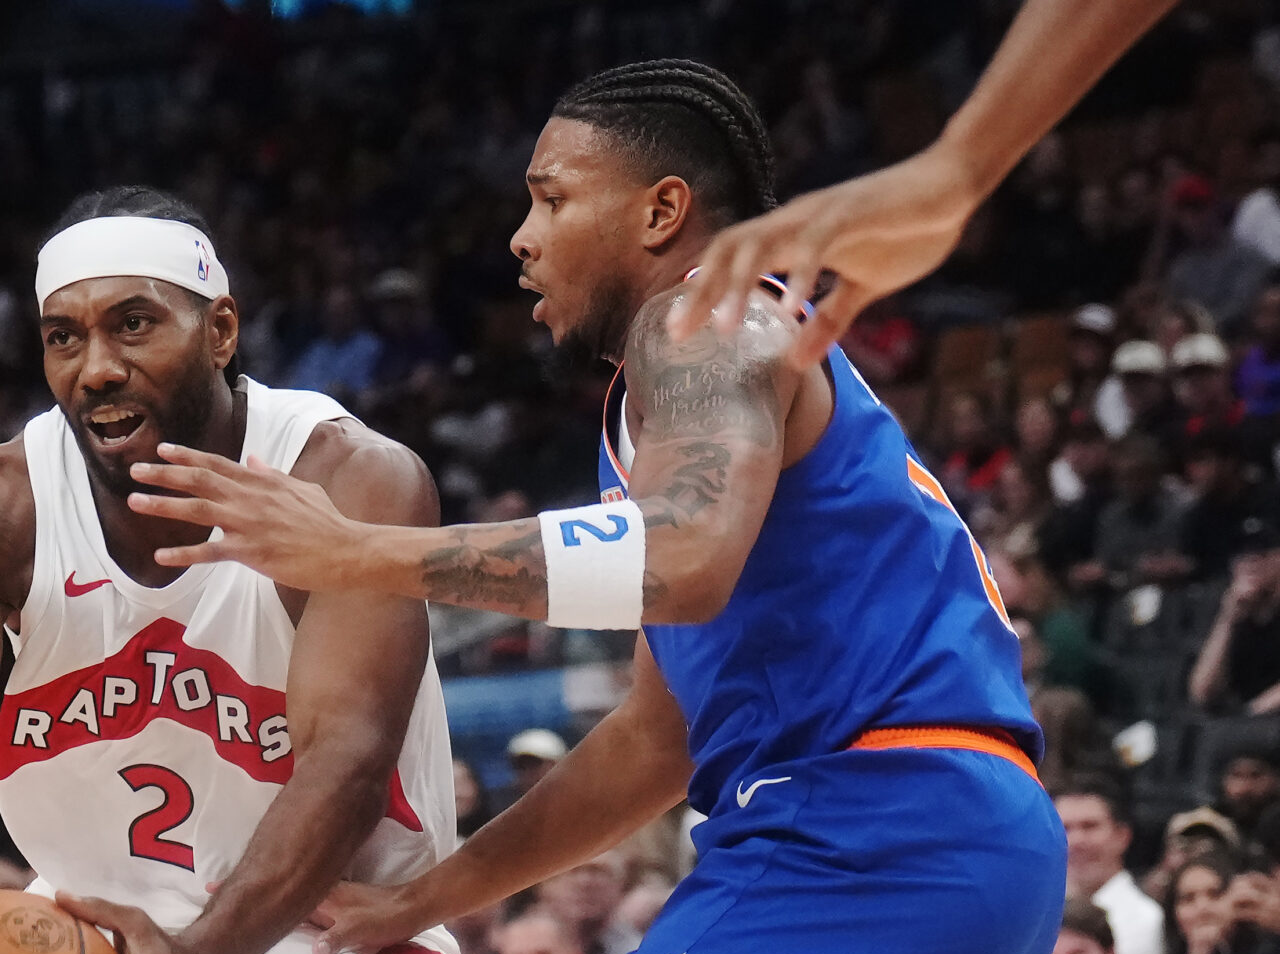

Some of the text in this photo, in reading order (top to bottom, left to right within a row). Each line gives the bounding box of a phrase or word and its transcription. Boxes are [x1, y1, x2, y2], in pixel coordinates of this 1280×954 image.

[559, 514, 629, 548] 2
[11, 650, 293, 763] RAPTORS
[117, 762, 195, 874] 2
